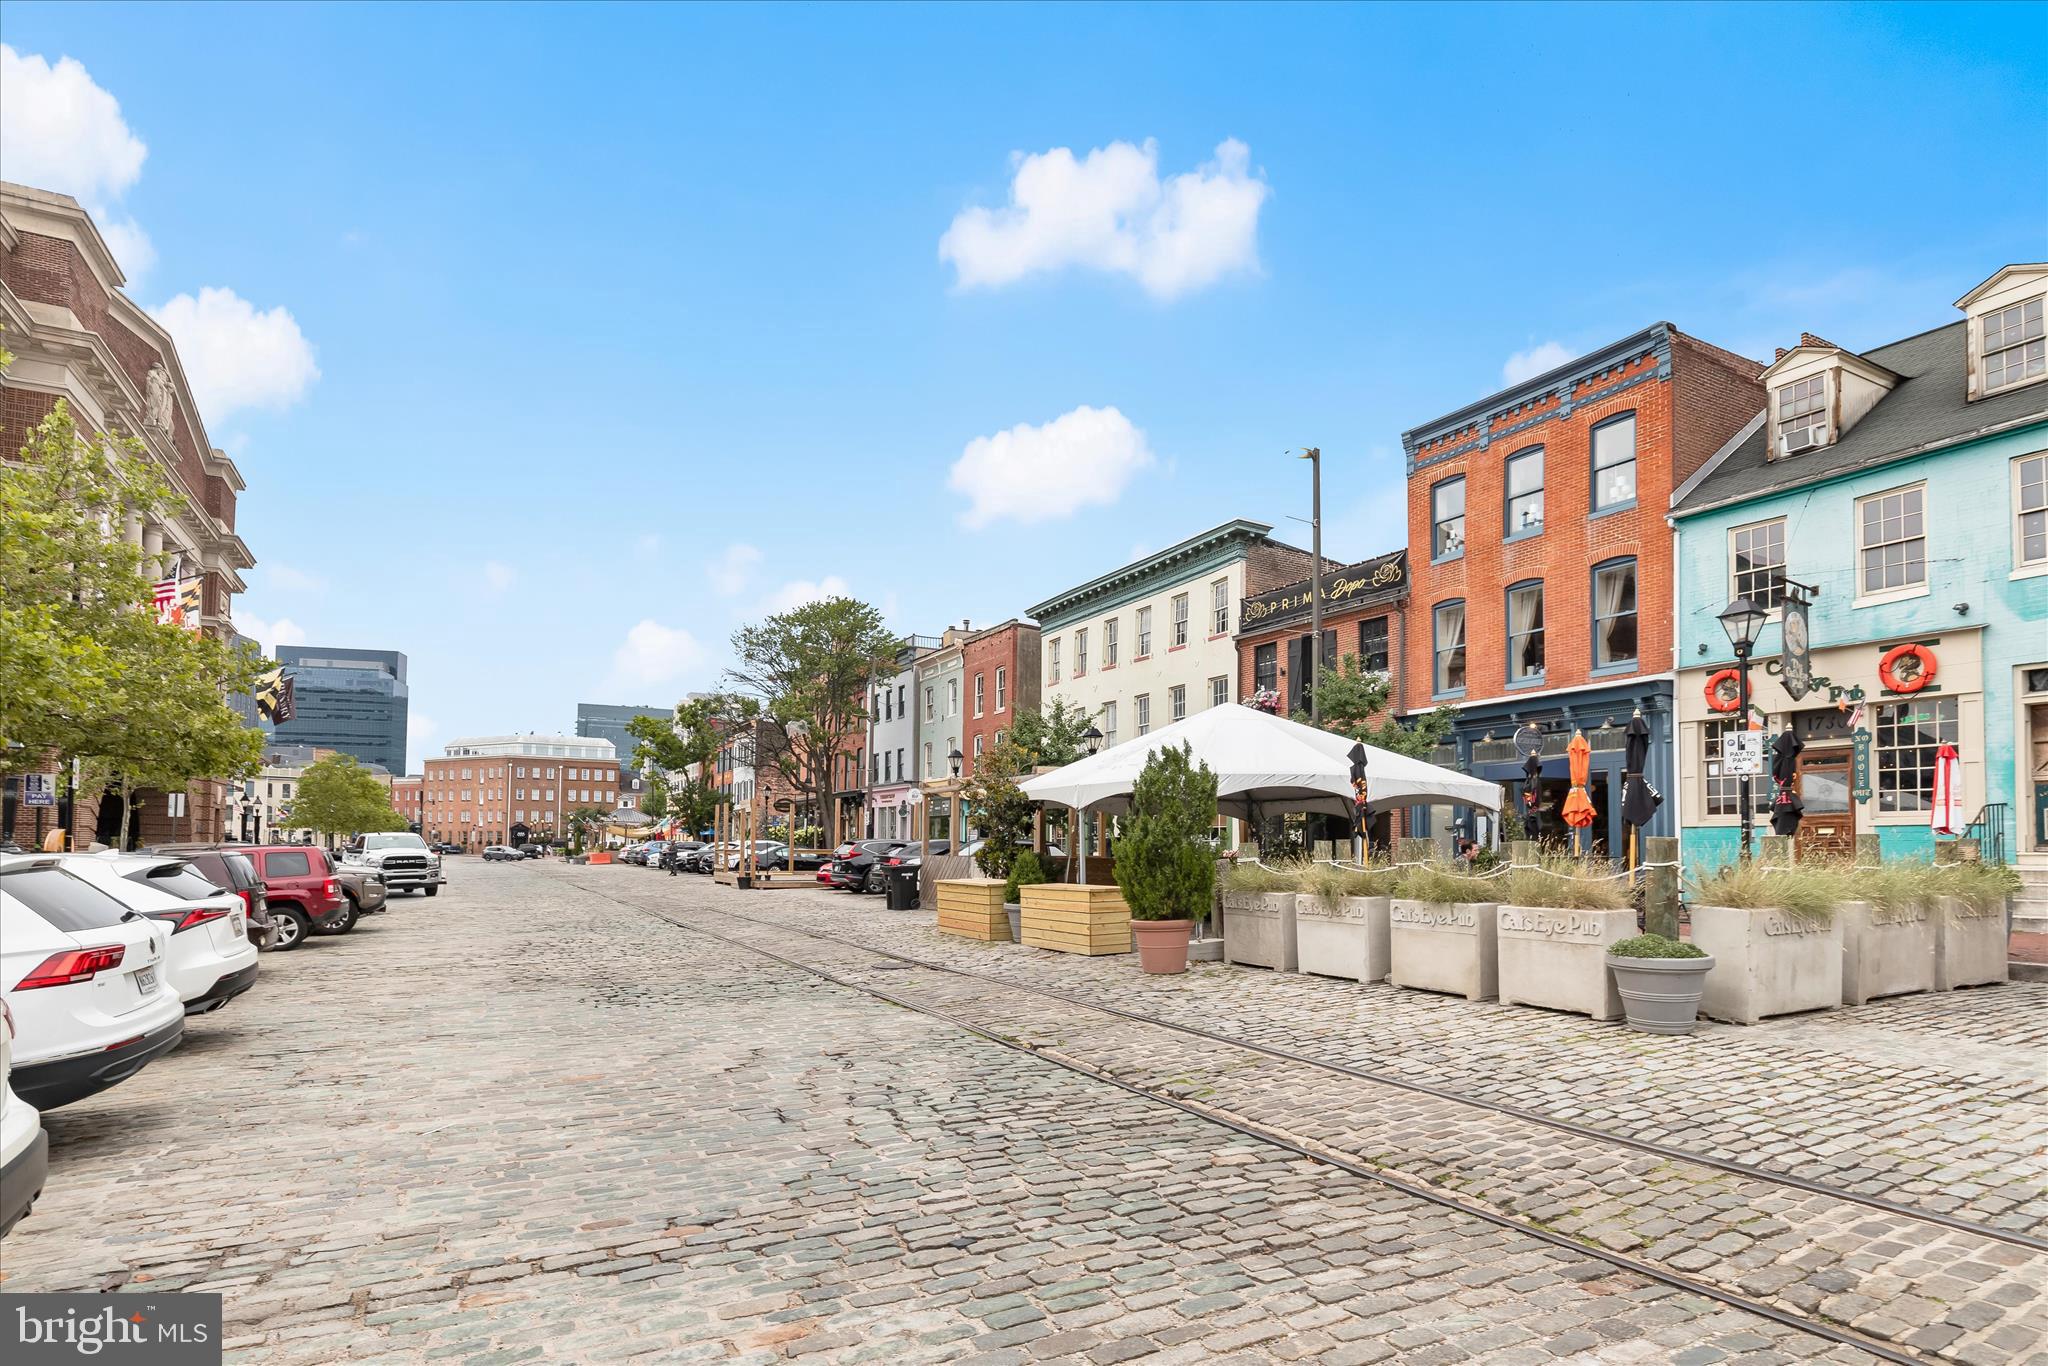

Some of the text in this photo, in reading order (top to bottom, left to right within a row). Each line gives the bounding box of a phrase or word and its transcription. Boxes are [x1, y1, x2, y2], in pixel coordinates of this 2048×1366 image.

[1330, 578, 1366, 599] Dopo
[1448, 907, 1475, 927] Pub
[1534, 912, 1567, 936] Eye
[1567, 912, 1601, 937] Pub
